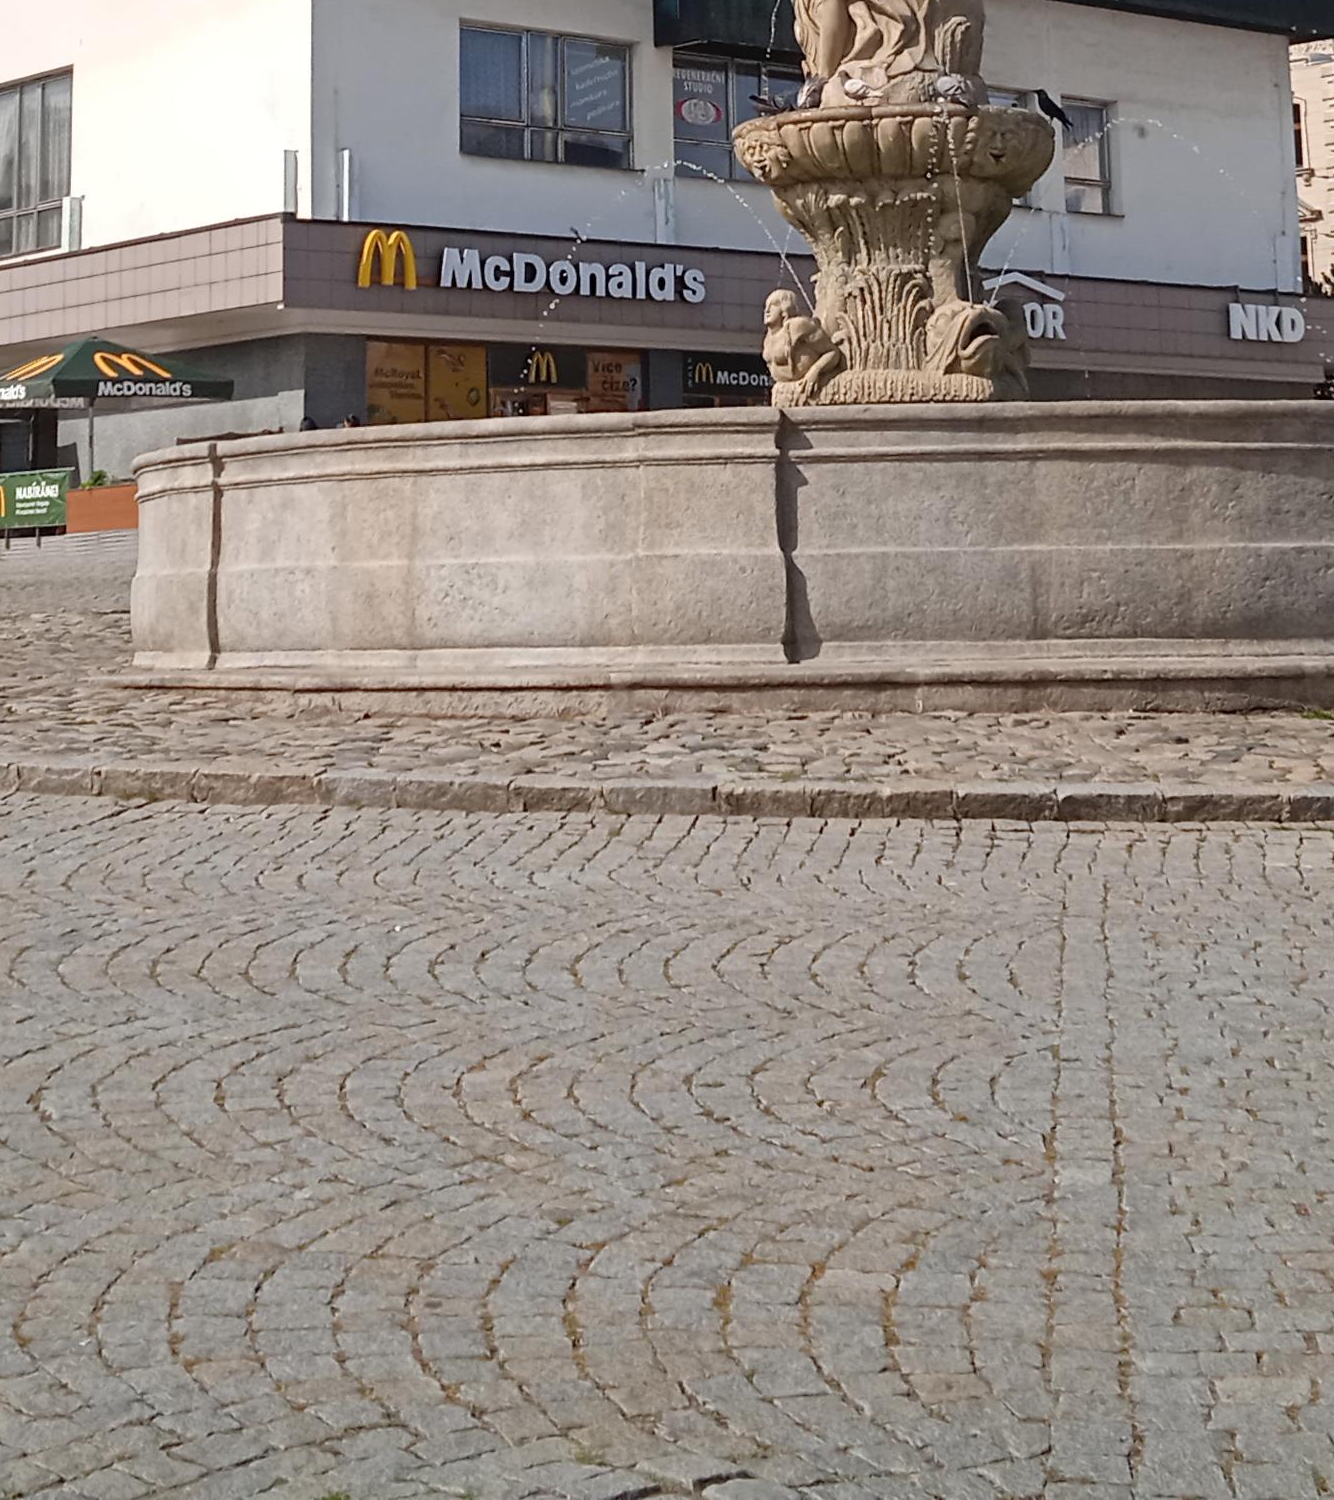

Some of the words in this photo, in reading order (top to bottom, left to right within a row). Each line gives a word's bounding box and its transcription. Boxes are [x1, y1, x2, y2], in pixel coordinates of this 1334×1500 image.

[683, 81, 714, 94] STUDIO
[439, 247, 706, 303] McDonald's
[1228, 303, 1305, 343] NKD
[716, 370, 769, 387] McDon
[98, 380, 192, 398] McDonald's
